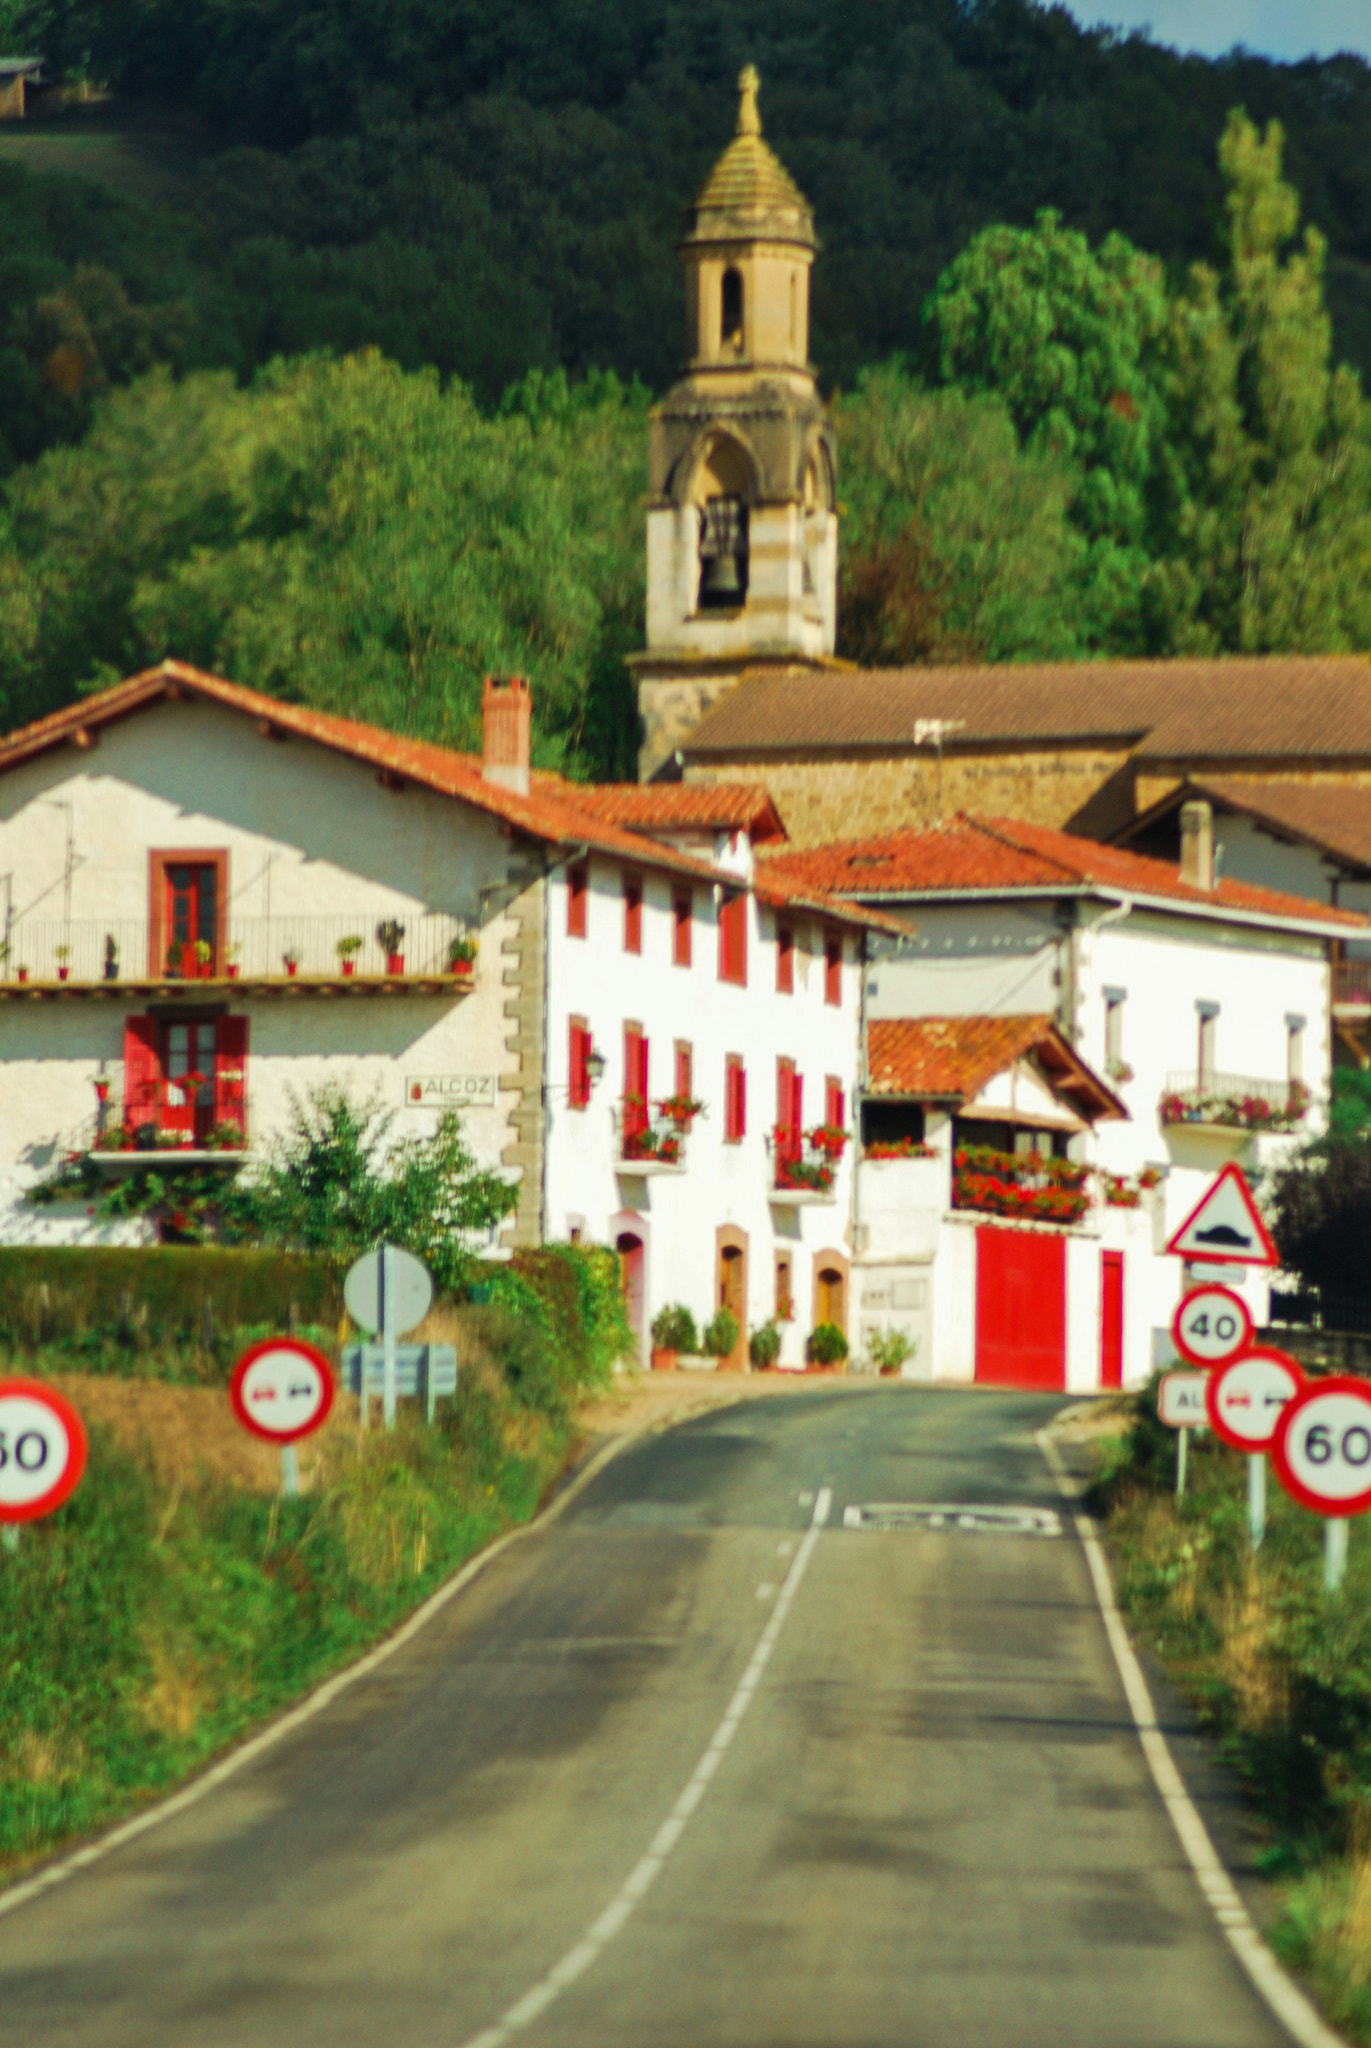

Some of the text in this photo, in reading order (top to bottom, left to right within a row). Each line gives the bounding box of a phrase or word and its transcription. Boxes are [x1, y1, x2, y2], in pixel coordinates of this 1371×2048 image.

[425, 1078, 490, 1094] ALCOZ
[1189, 1313, 1236, 1341] 40
[0, 1431, 48, 1472] 0
[1305, 1425, 1371, 1467] 60
